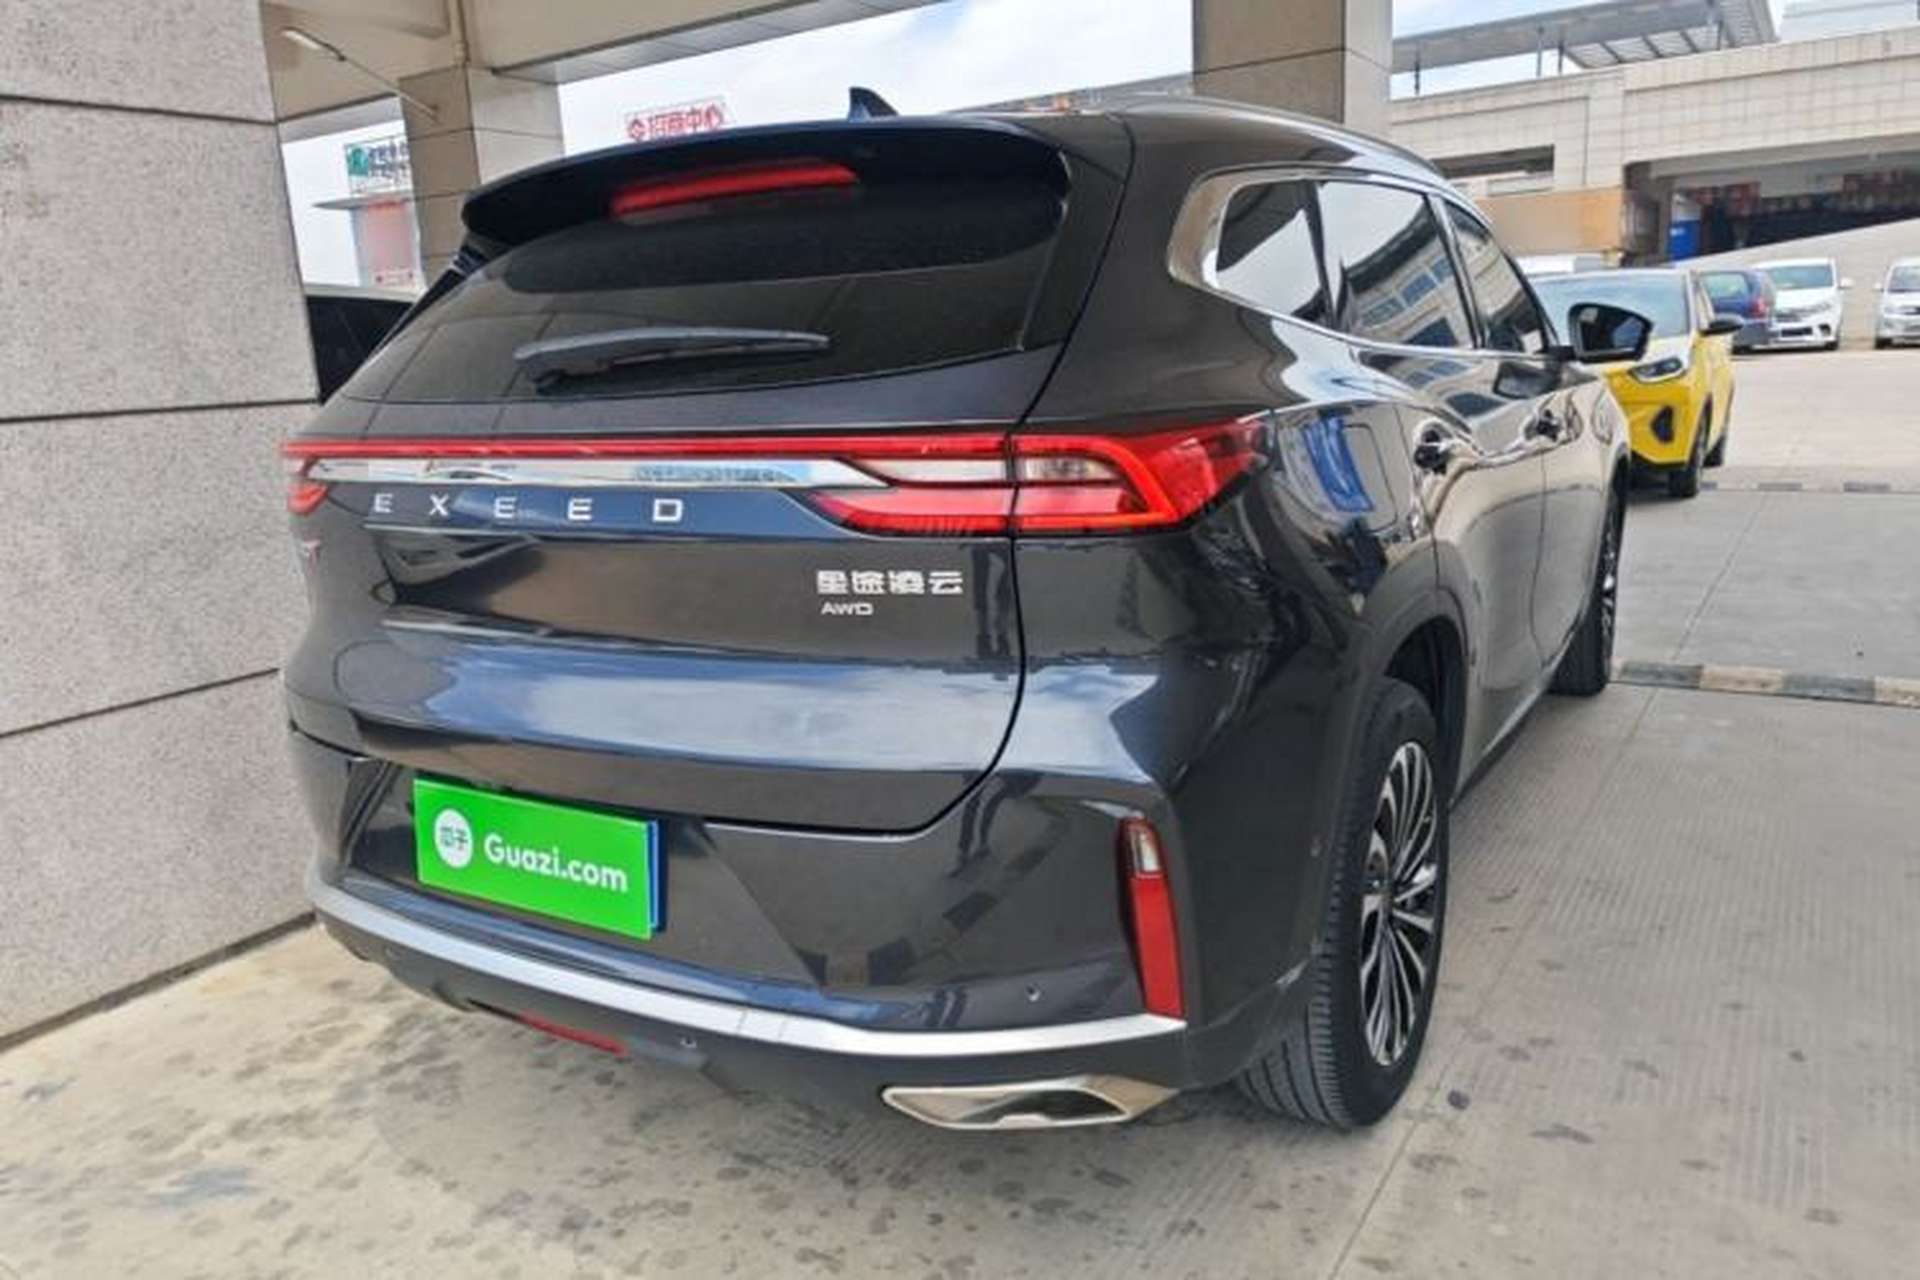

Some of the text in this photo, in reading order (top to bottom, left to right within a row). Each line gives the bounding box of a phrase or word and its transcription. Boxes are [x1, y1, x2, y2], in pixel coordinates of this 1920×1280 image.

[372, 492, 684, 524] EXEED
[817, 570, 964, 595] 星途凌云
[820, 601, 874, 616] AWD
